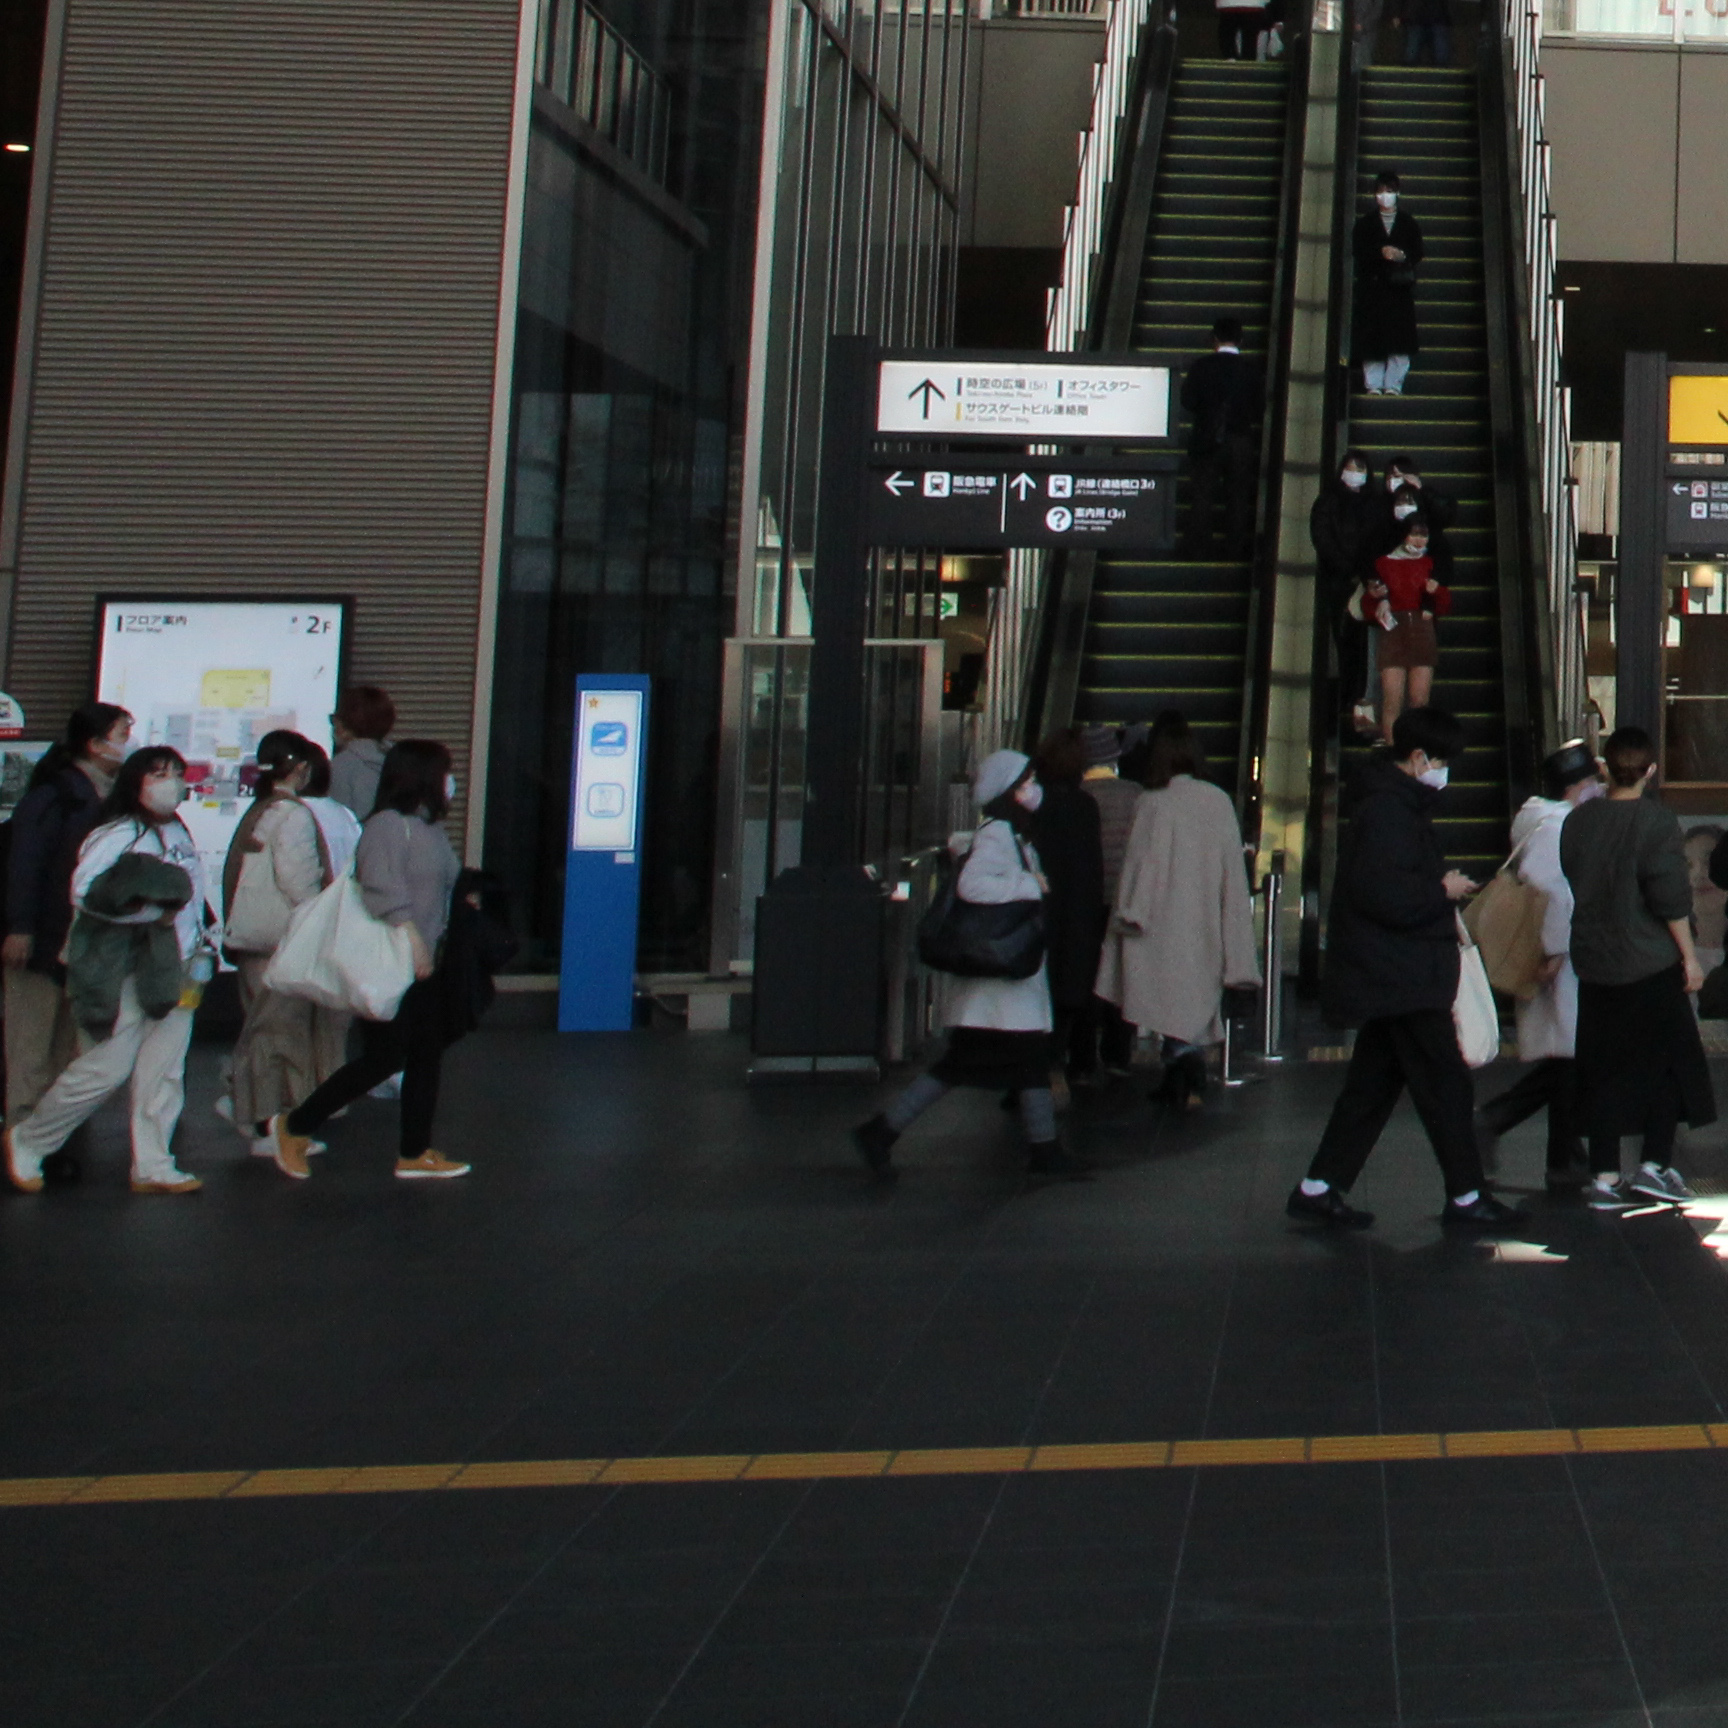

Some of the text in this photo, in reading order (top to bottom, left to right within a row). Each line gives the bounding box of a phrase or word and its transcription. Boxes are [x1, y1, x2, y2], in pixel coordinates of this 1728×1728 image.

[966, 377, 1027, 390] 時空の広場
[1068, 381, 1141, 392] オフィスタワー
[126, 615, 331, 634] フロア案内 2F
